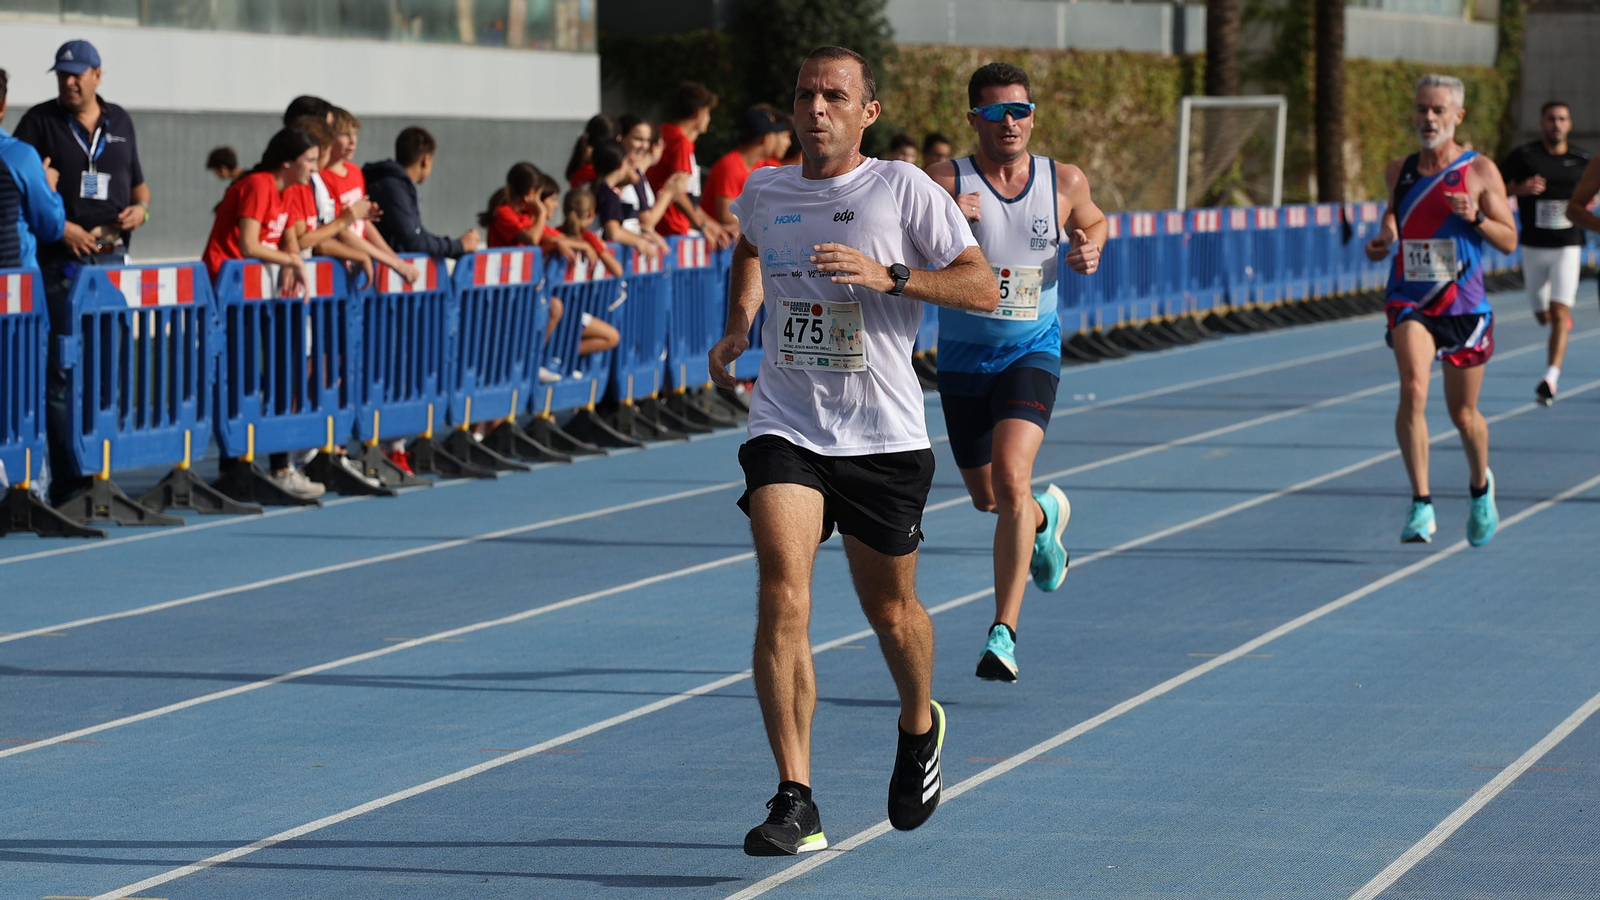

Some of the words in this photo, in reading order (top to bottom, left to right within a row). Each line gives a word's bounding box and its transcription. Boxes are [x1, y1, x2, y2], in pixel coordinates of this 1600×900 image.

[775, 214, 801, 224] HOKA
[833, 209, 854, 224] edp
[1030, 237, 1047, 247] OTSO
[1409, 252, 1430, 264] 114
[791, 270, 802, 278] edp
[1000, 280, 1009, 299] 5
[784, 317, 823, 344] 475
